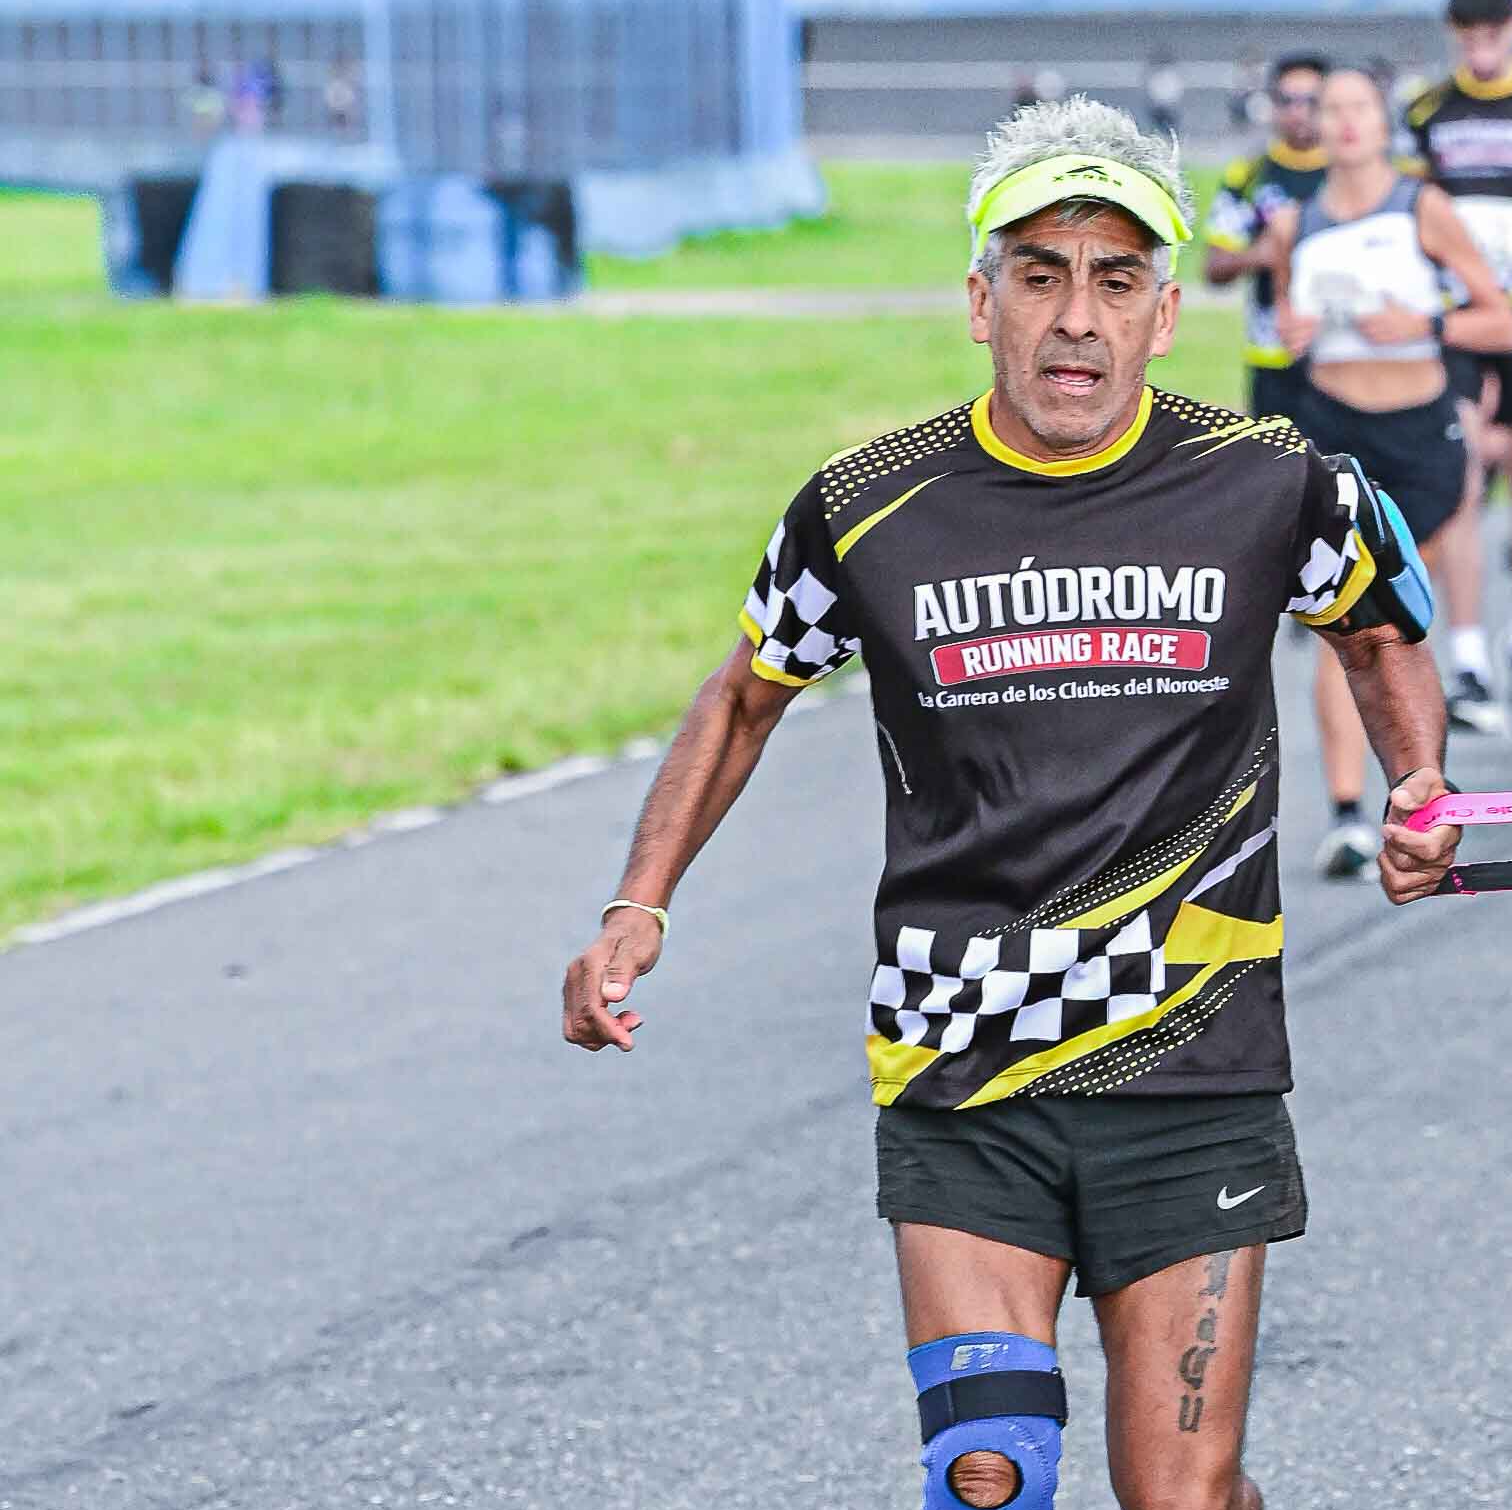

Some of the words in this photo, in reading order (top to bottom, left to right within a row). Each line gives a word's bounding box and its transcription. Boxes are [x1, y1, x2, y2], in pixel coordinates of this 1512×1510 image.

[913, 555, 1227, 641] AUTÓDROMO
[961, 632, 1092, 678] RUNNING
[1100, 632, 1179, 665] RACE
[934, 690, 999, 708] Carrera
[1001, 685, 1026, 703] de
[1029, 683, 1056, 701] los
[1058, 680, 1121, 699] Clubes
[1123, 677, 1152, 695] del
[1156, 675, 1230, 694] Noroeste
